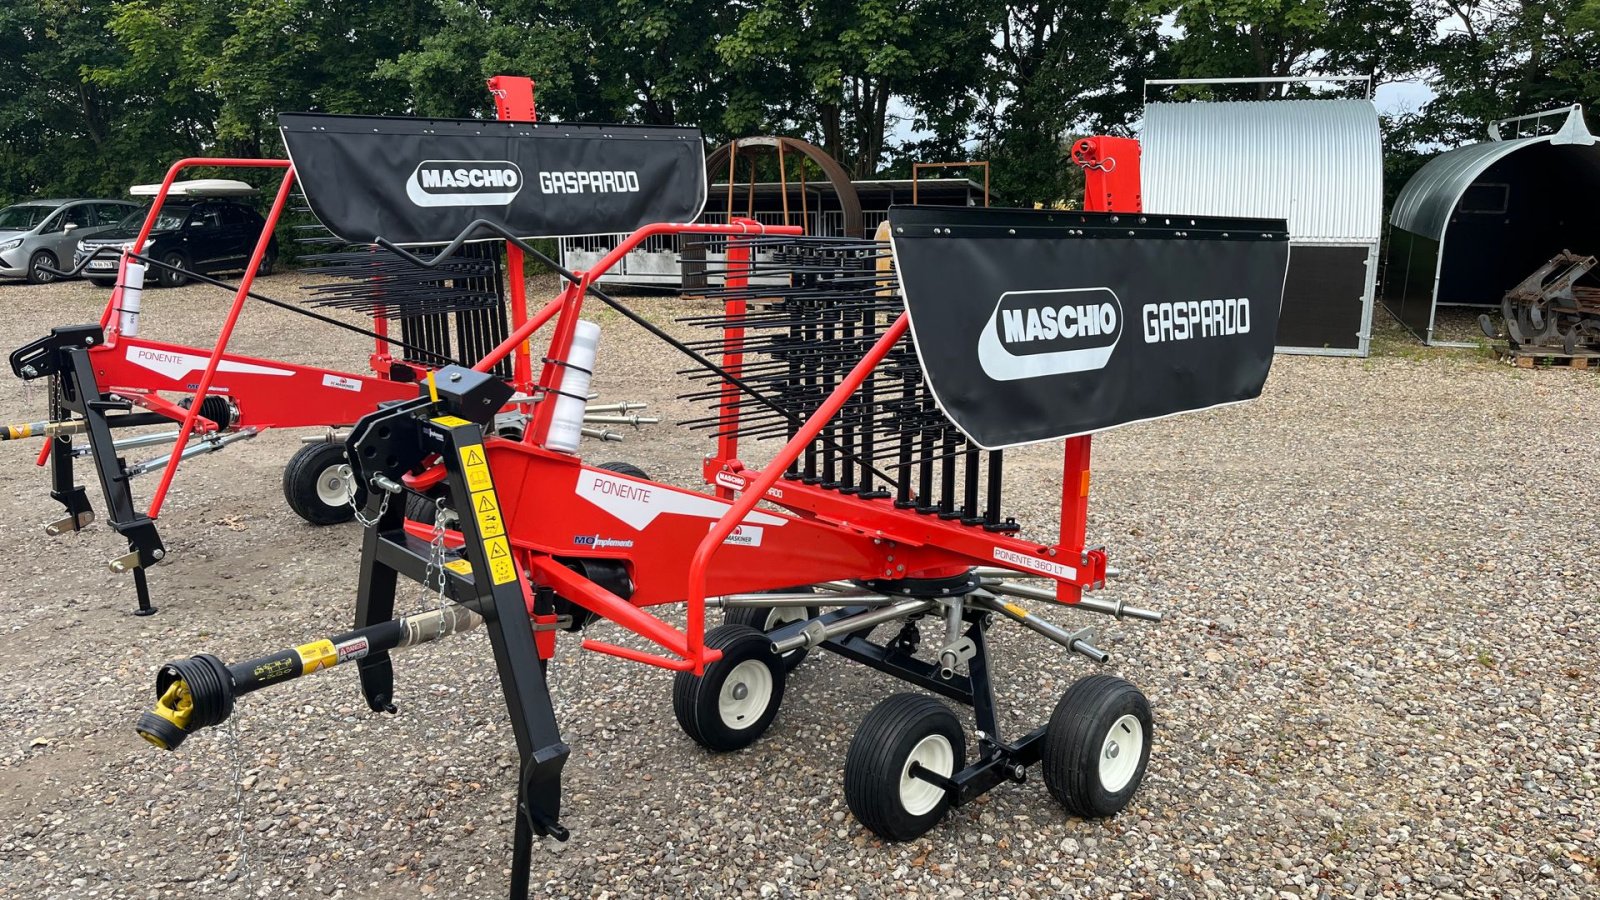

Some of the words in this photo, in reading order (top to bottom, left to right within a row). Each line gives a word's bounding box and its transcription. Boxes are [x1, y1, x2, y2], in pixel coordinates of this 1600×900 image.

[421, 168, 518, 188] MASCHIO
[539, 171, 640, 194] GASPARDO
[1002, 302, 1117, 343] MASCHIO
[1142, 298, 1250, 344] GASPARDO
[138, 350, 183, 365] PONENTE
[593, 478, 652, 503] PONENTE
[719, 472, 745, 485] MASCHIO
[994, 549, 1032, 567] PONENTE
[1034, 560, 1052, 572] 360
[1054, 565, 1064, 575] LT
[345, 641, 367, 653] DANGER
